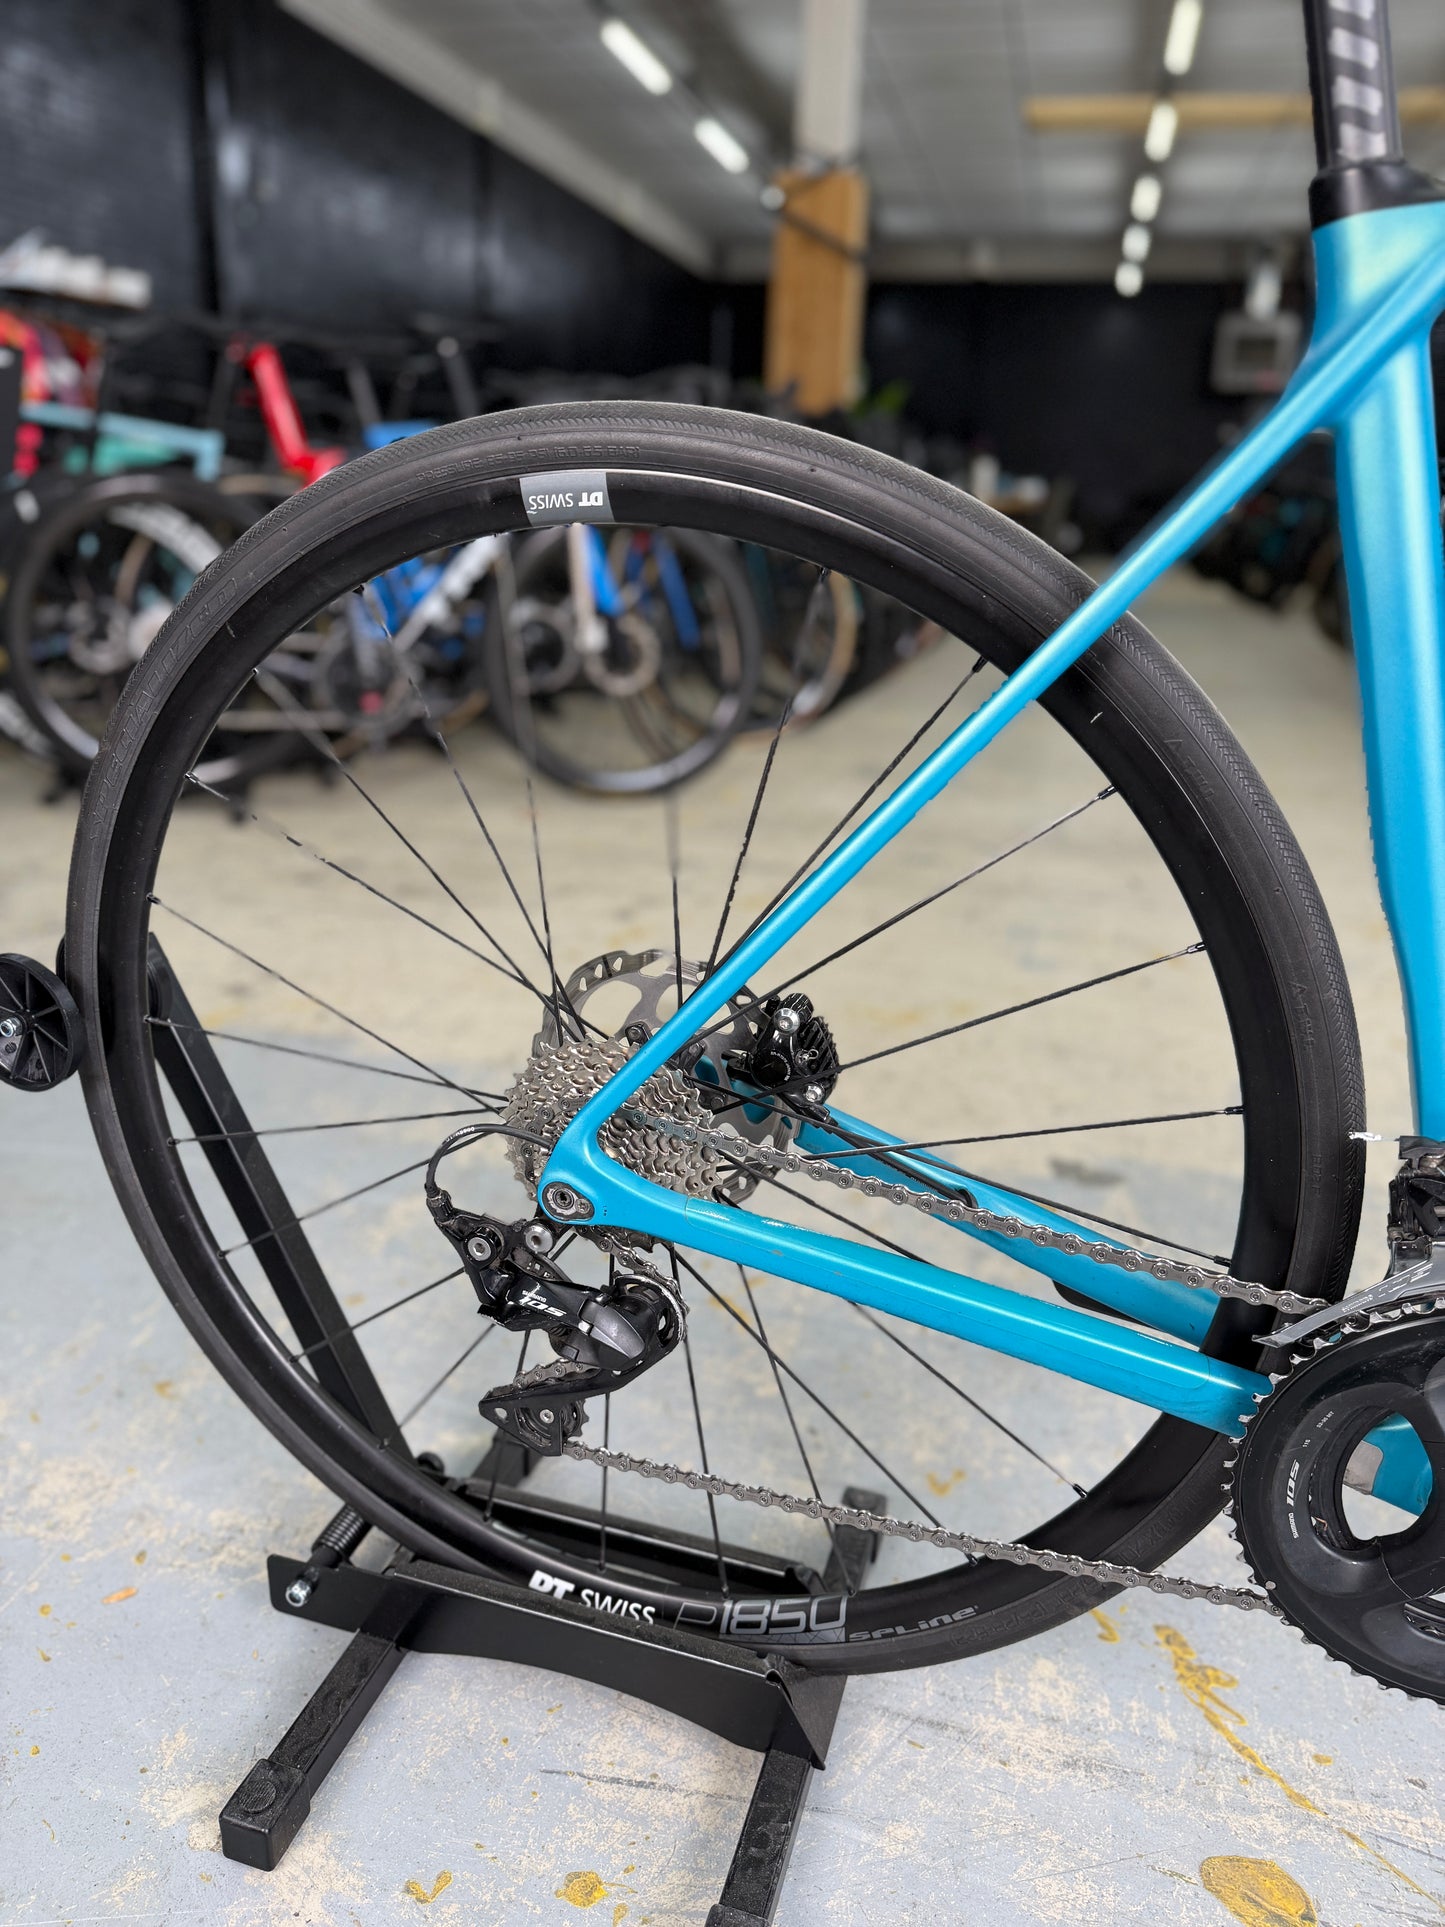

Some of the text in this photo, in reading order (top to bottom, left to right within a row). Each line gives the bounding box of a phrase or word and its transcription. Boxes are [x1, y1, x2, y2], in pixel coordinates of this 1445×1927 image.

[528, 491, 604, 511] DT SWISS
[1286, 1459, 1300, 1507] 105
[528, 1569, 575, 1600] DT
